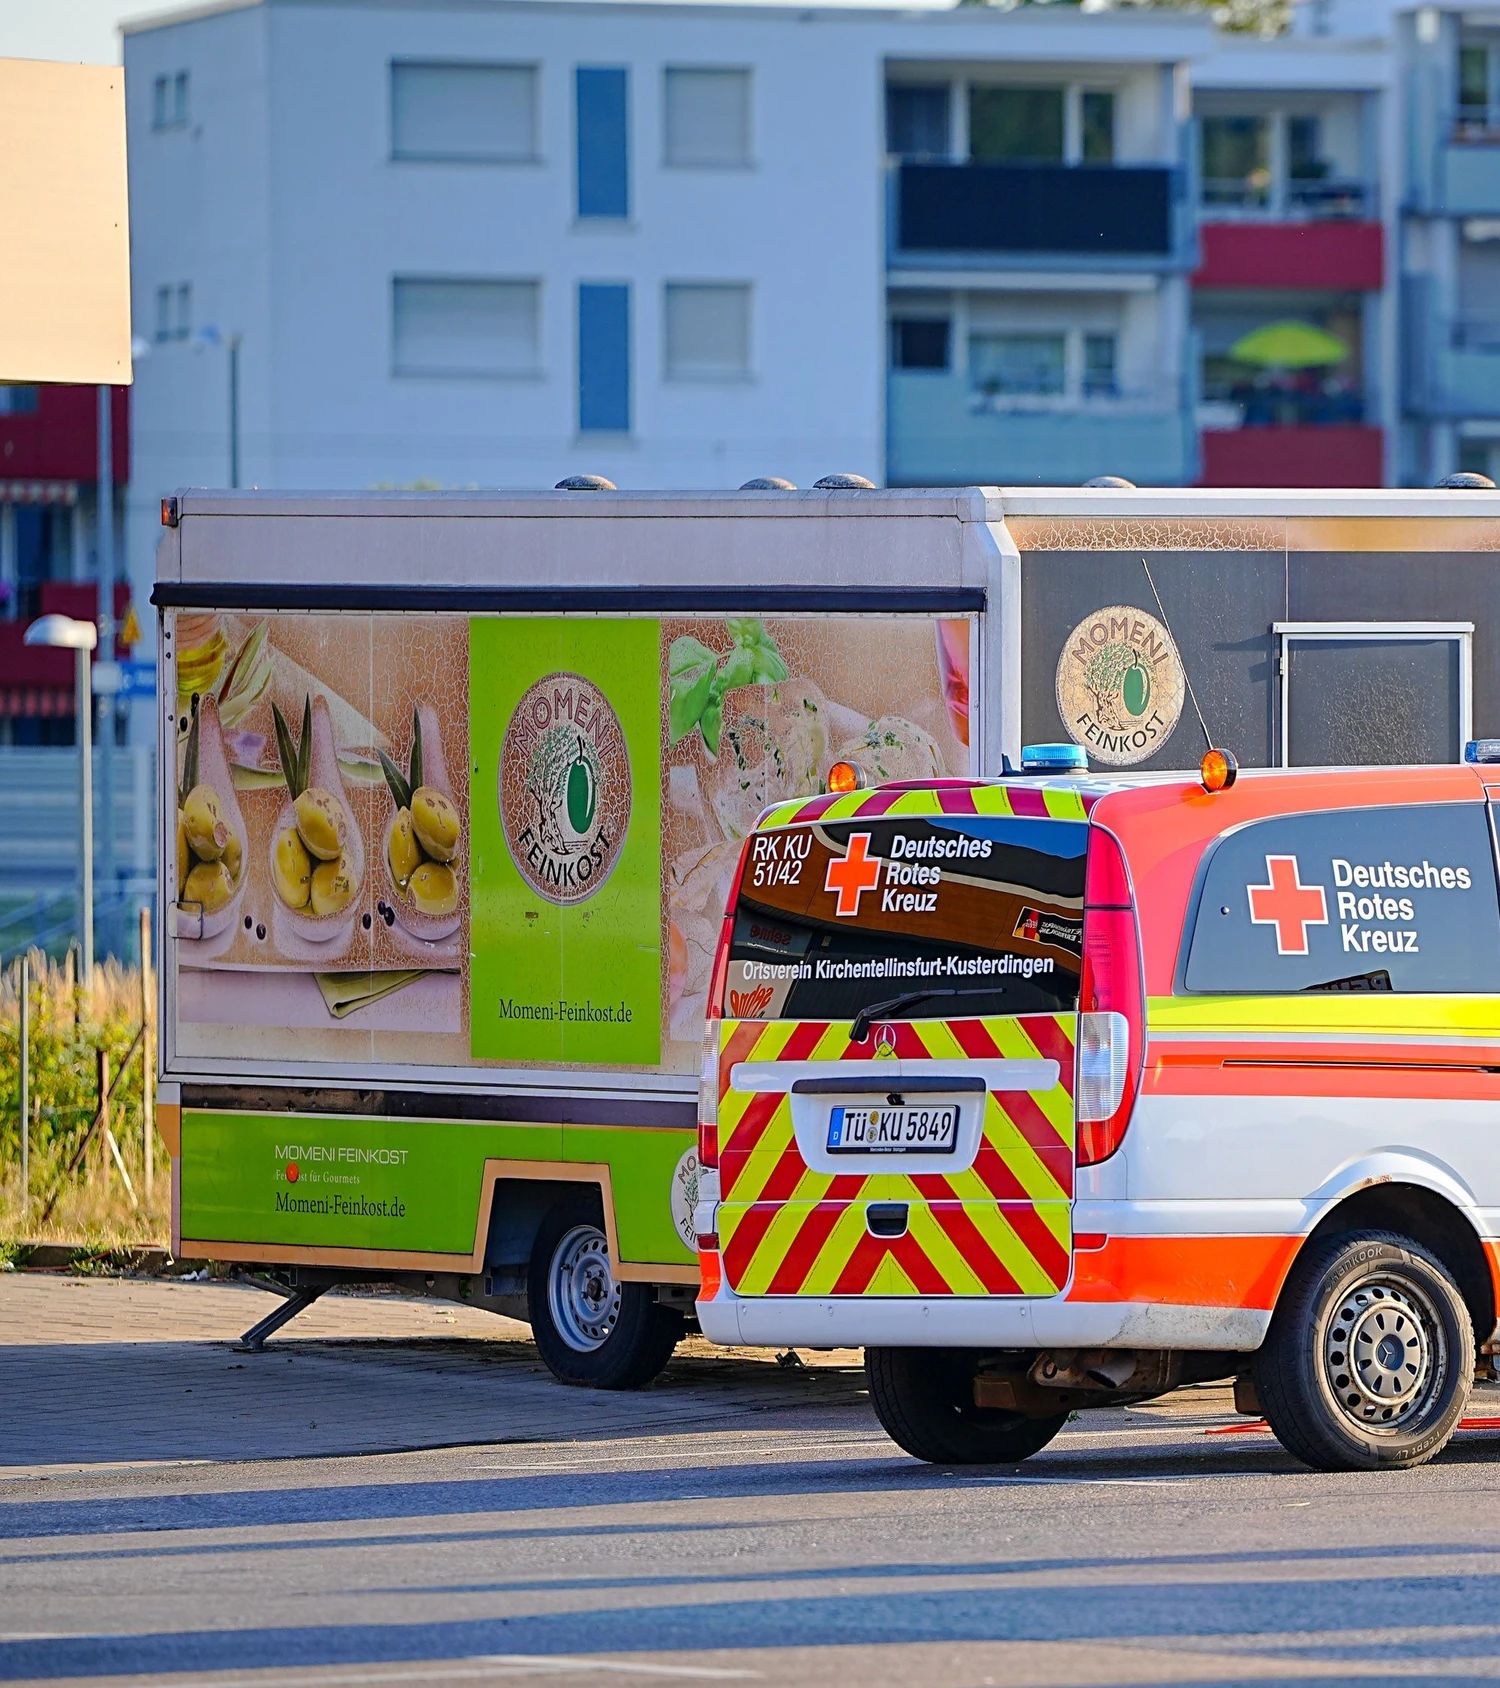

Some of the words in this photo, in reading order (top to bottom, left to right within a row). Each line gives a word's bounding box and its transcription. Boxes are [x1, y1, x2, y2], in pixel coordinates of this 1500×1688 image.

[1072, 617, 1169, 665] MOMENI
[514, 688, 616, 760] MOMENI
[1076, 710, 1165, 753] FEINKOST
[518, 825, 610, 886] FEINKOST
[752, 835, 782, 861] RK
[783, 834, 813, 860] KU
[890, 834, 993, 859] Deutsches
[753, 860, 802, 887] 51/42
[885, 862, 941, 886] Rotes
[1332, 859, 1472, 889] Deutsches
[881, 888, 938, 912] Kreuz
[1337, 891, 1414, 920] Rotes
[1341, 923, 1419, 952] Kreuz
[743, 960, 812, 980] Ortsverein
[815, 954, 1054, 979] Kirchentellinsfurt-Kusterdingen
[499, 998, 632, 1022] Momeni-Feinkost.de
[845, 1113, 868, 1141] TÜ
[878, 1112, 903, 1141] KU
[906, 1112, 951, 1141] 5849
[275, 1145, 336, 1162] MOMENI
[338, 1147, 408, 1165] FEINKOST
[309, 1169, 321, 1182] für
[323, 1171, 360, 1184] Gourmets
[275, 1191, 406, 1218] Momeni-Feinkost.de
